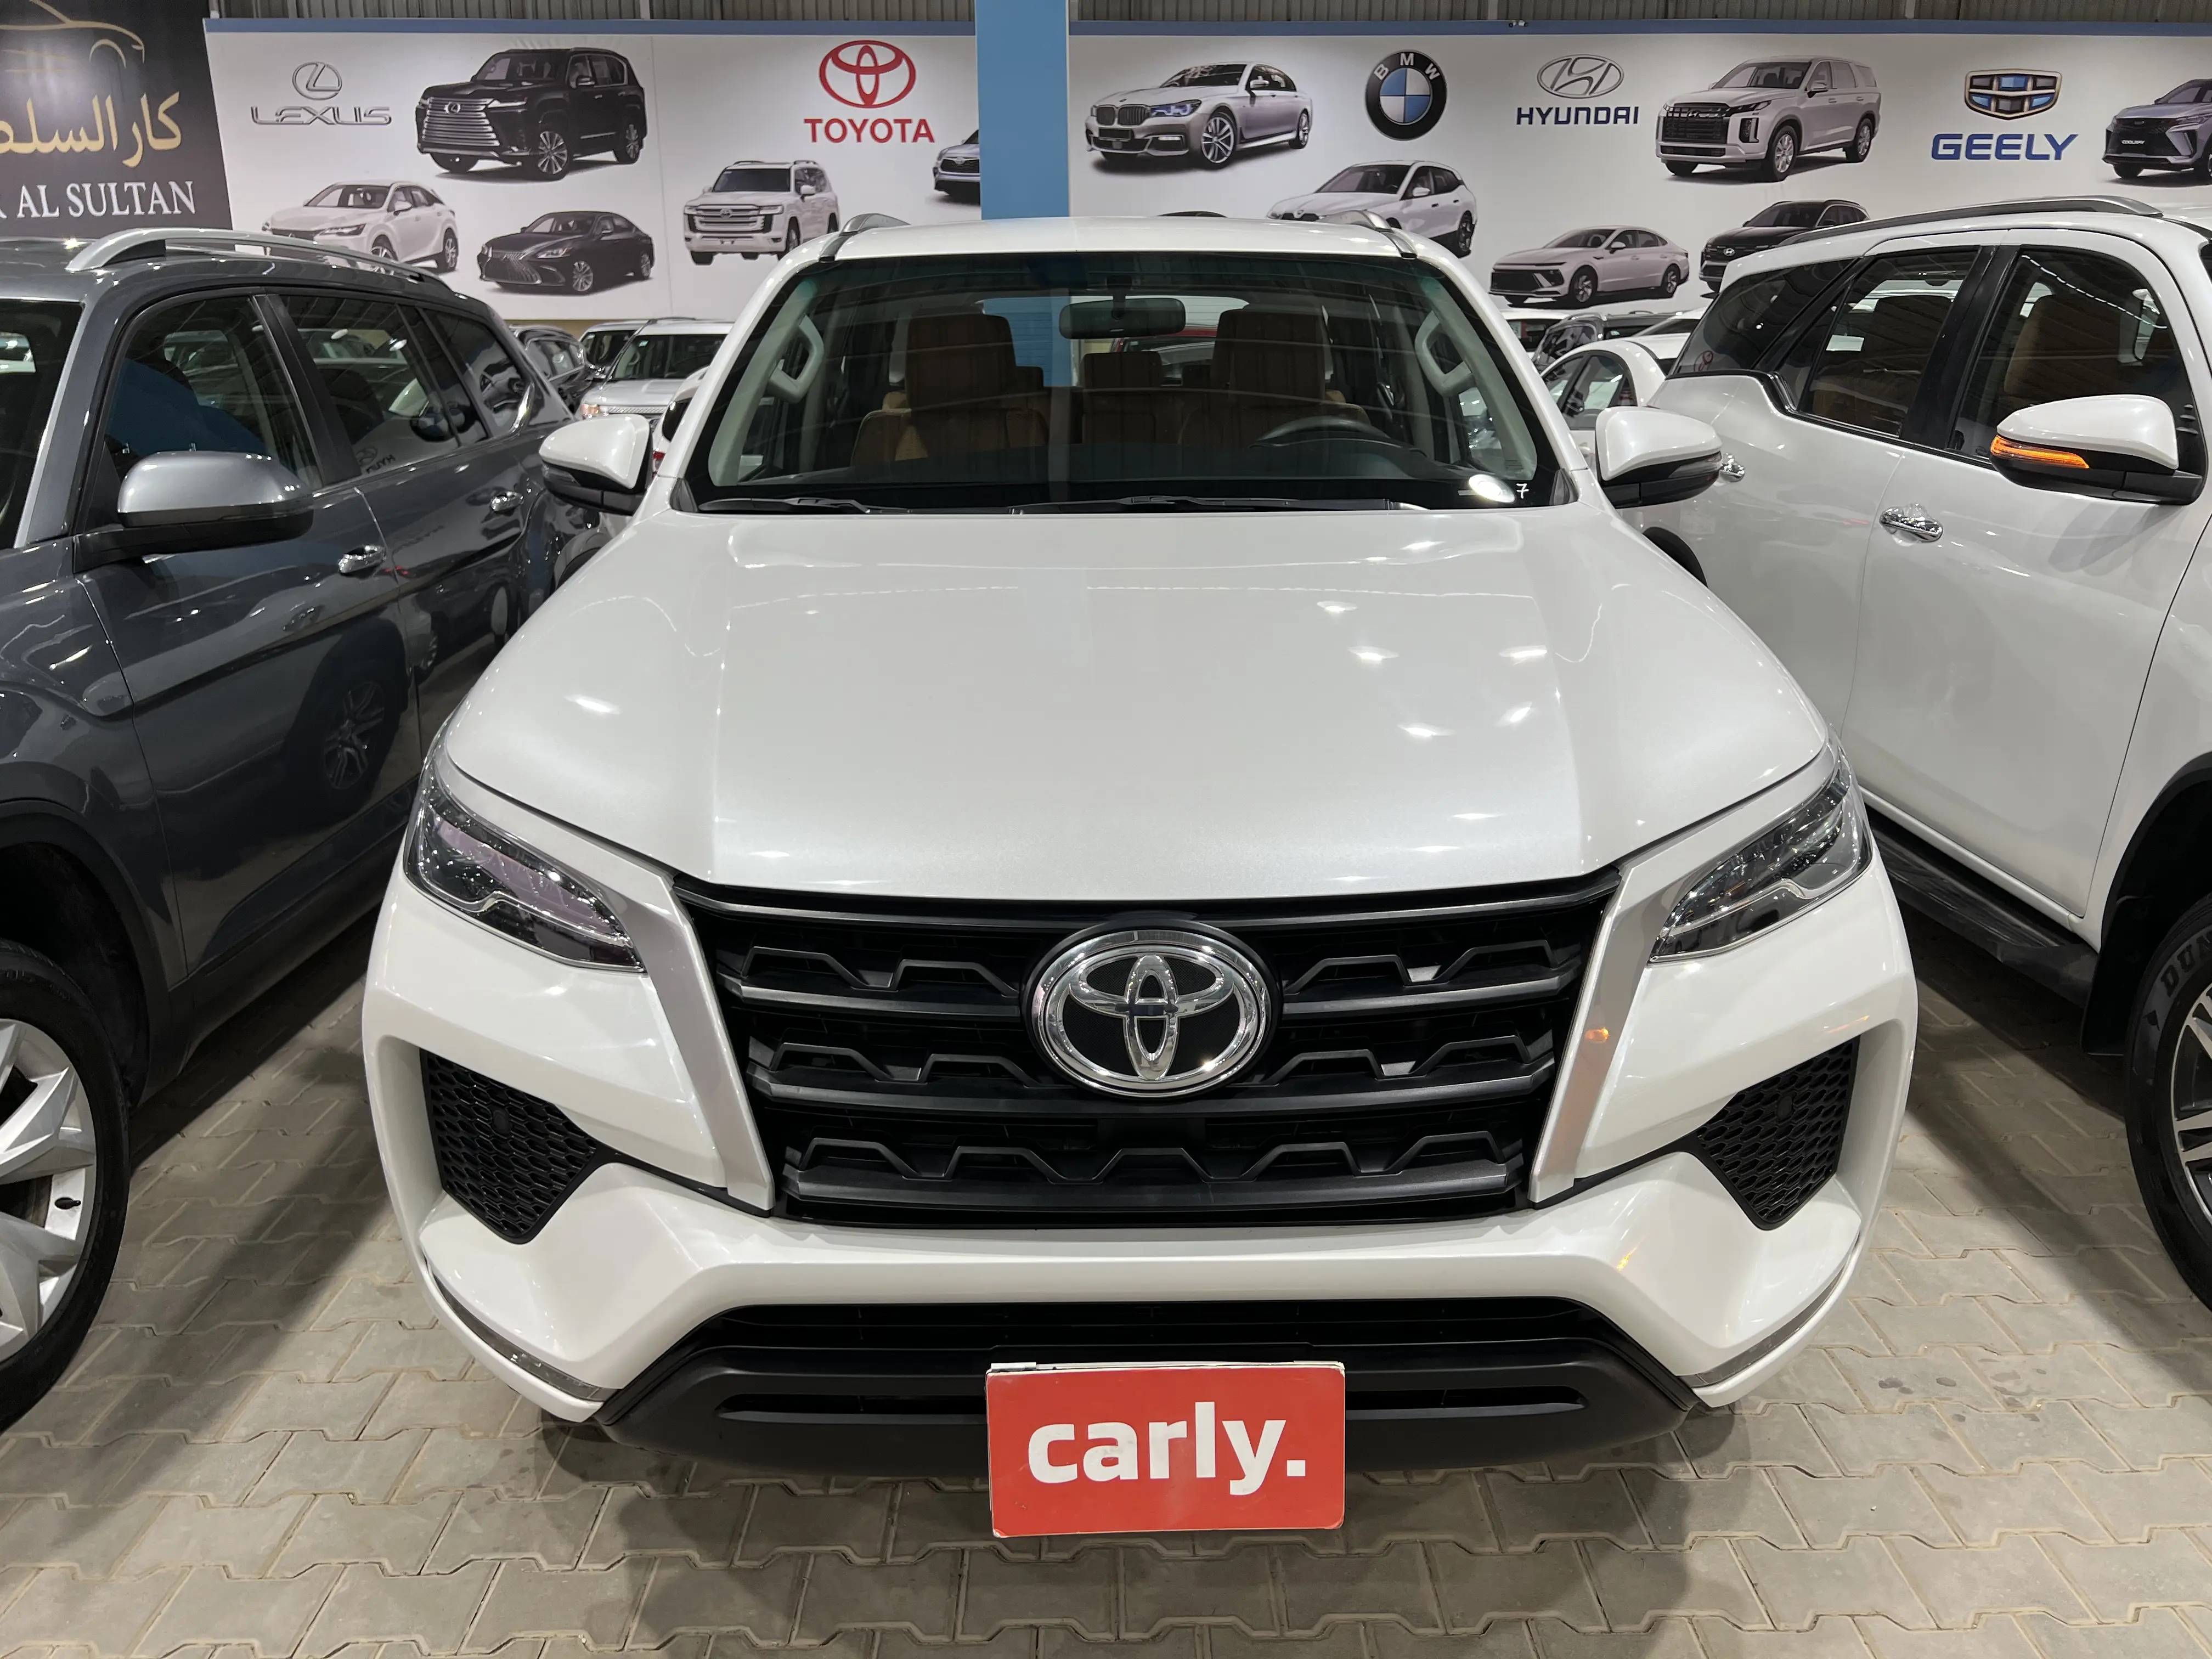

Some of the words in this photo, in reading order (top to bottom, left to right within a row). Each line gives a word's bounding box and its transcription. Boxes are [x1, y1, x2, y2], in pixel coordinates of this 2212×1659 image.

[1373, 52, 1440, 81] BMW
[250, 105, 392, 126] LEXUS
[1516, 106, 1639, 125] HYUNDAI
[122, 91, 182, 168] كار
[804, 117, 935, 143] TOYOTA
[1931, 133, 2079, 160] GEELY
[16, 184, 60, 218] AL
[66, 180, 196, 218] SULTAN
[1516, 483, 1530, 499] 7
[1028, 1401, 1307, 1496] carly.
